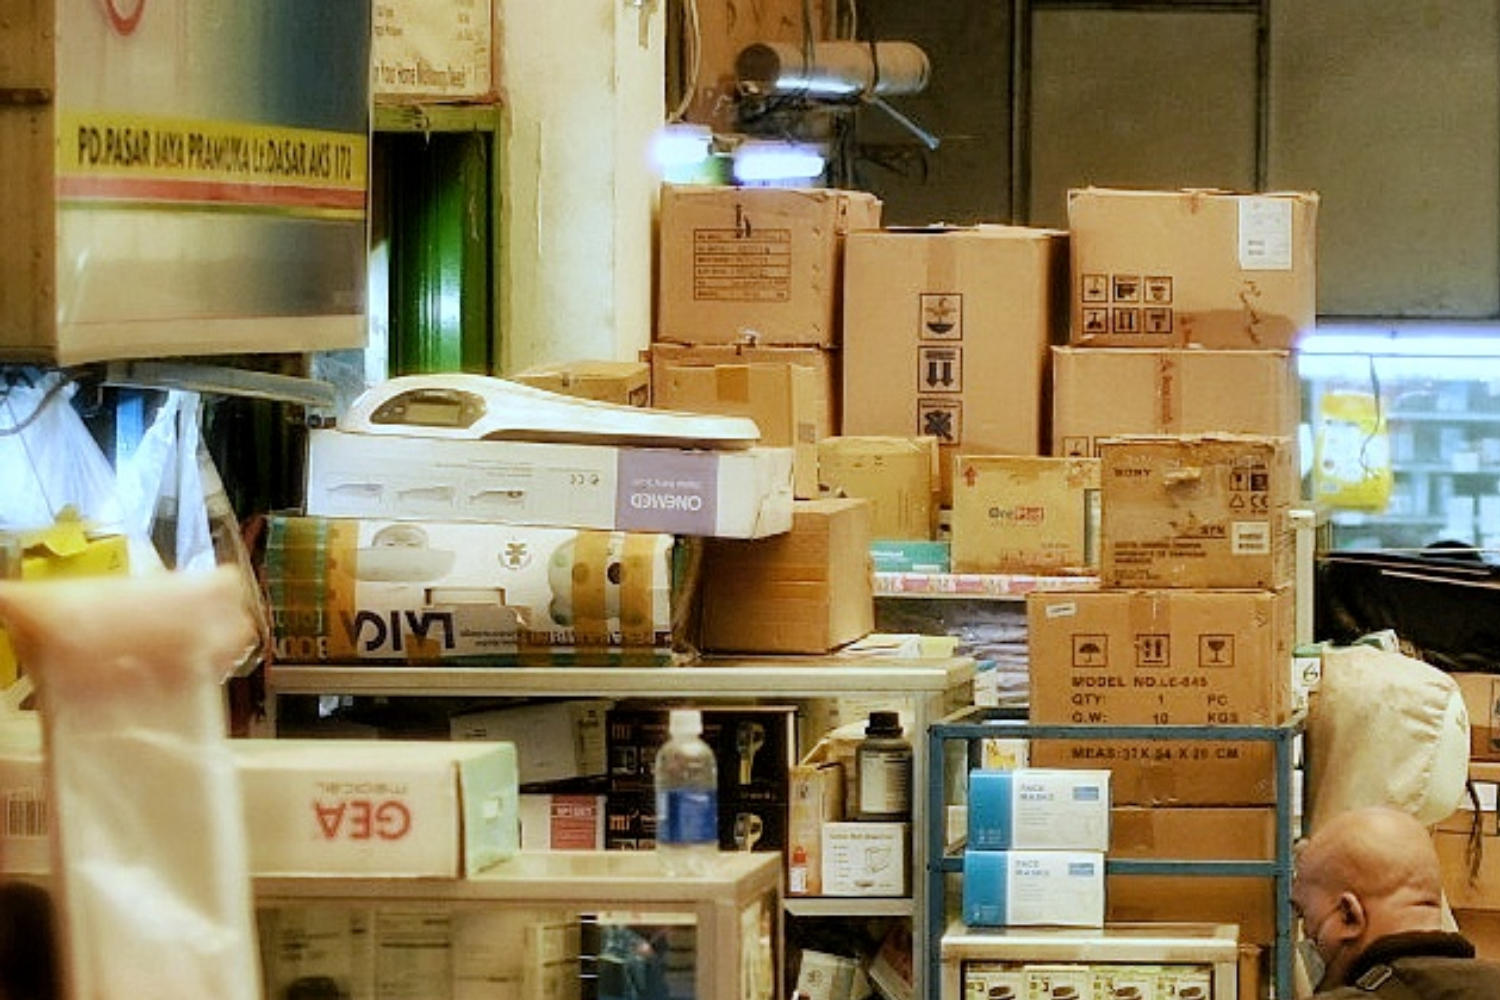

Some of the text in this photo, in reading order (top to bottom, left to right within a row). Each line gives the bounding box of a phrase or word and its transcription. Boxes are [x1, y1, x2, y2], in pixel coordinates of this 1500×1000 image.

[153, 131, 184, 168] JAYA
[187, 132, 248, 173] PRAMUKA
[631, 492, 702, 511] ONEMED
[1071, 676, 1126, 688] MODEL
[1158, 694, 1164, 704] 1
[1207, 694, 1228, 706] PC
[1153, 713, 1169, 725] 10
[1216, 748, 1239, 759] CM
[315, 801, 411, 840] GEA
